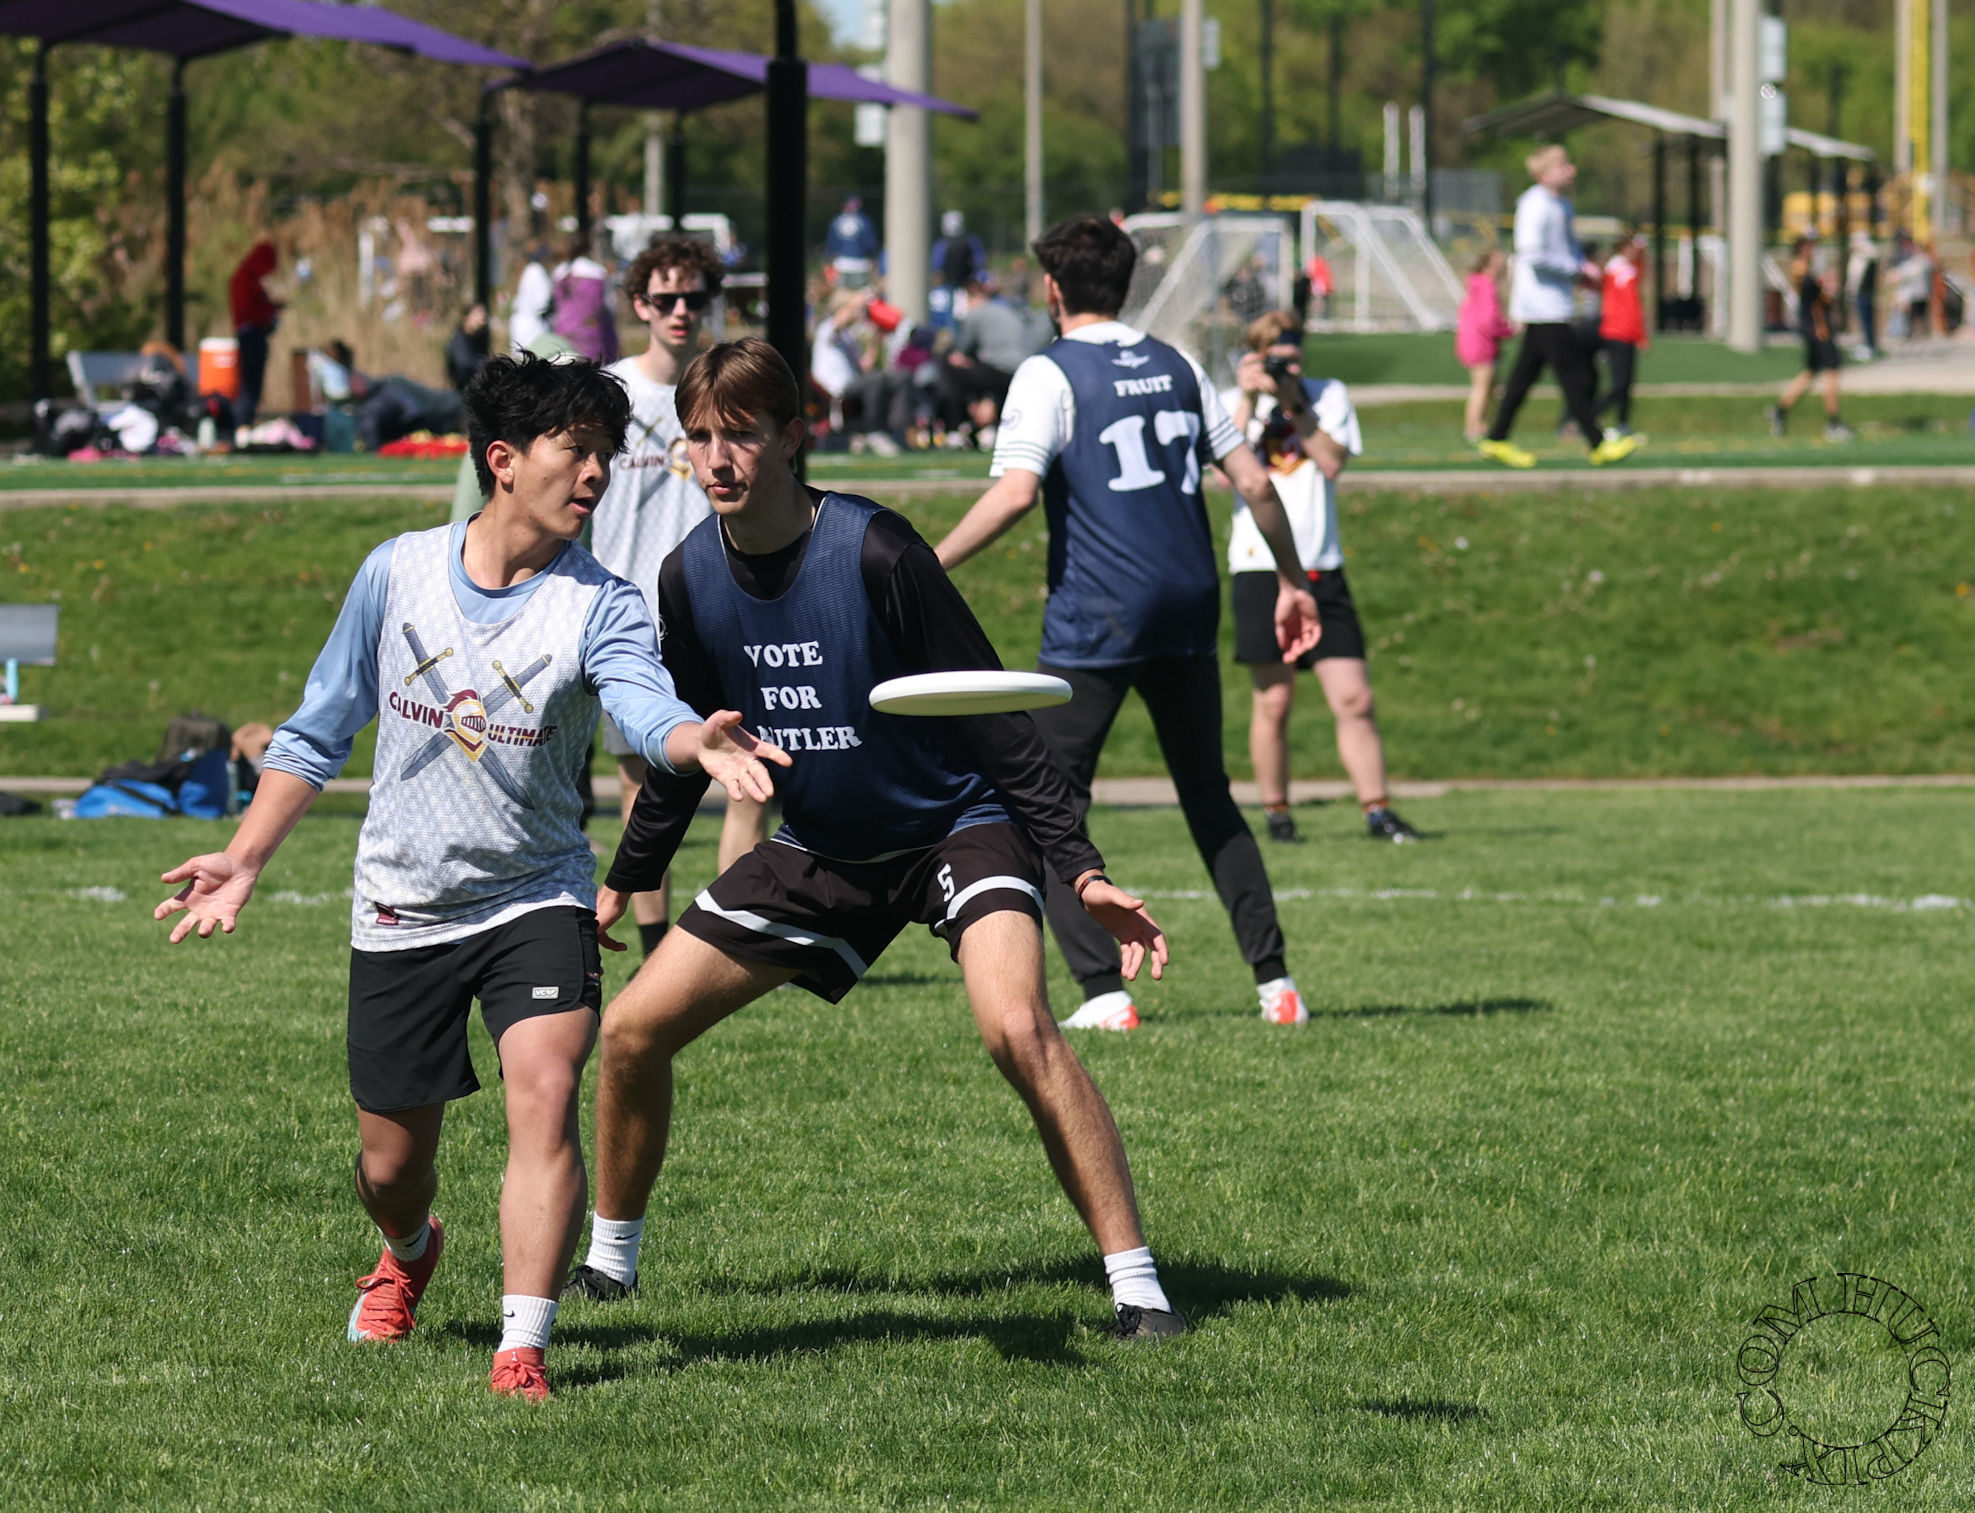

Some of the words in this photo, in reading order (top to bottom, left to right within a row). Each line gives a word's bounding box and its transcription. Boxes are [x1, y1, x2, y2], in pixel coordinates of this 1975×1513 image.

[1113, 374, 1173, 398] FRUIT
[619, 455, 665, 470] CALVIN
[1098, 409, 1201, 495] 17
[743, 640, 823, 669] VOTE
[760, 685, 822, 711] FOR
[936, 863, 956, 902] 5
